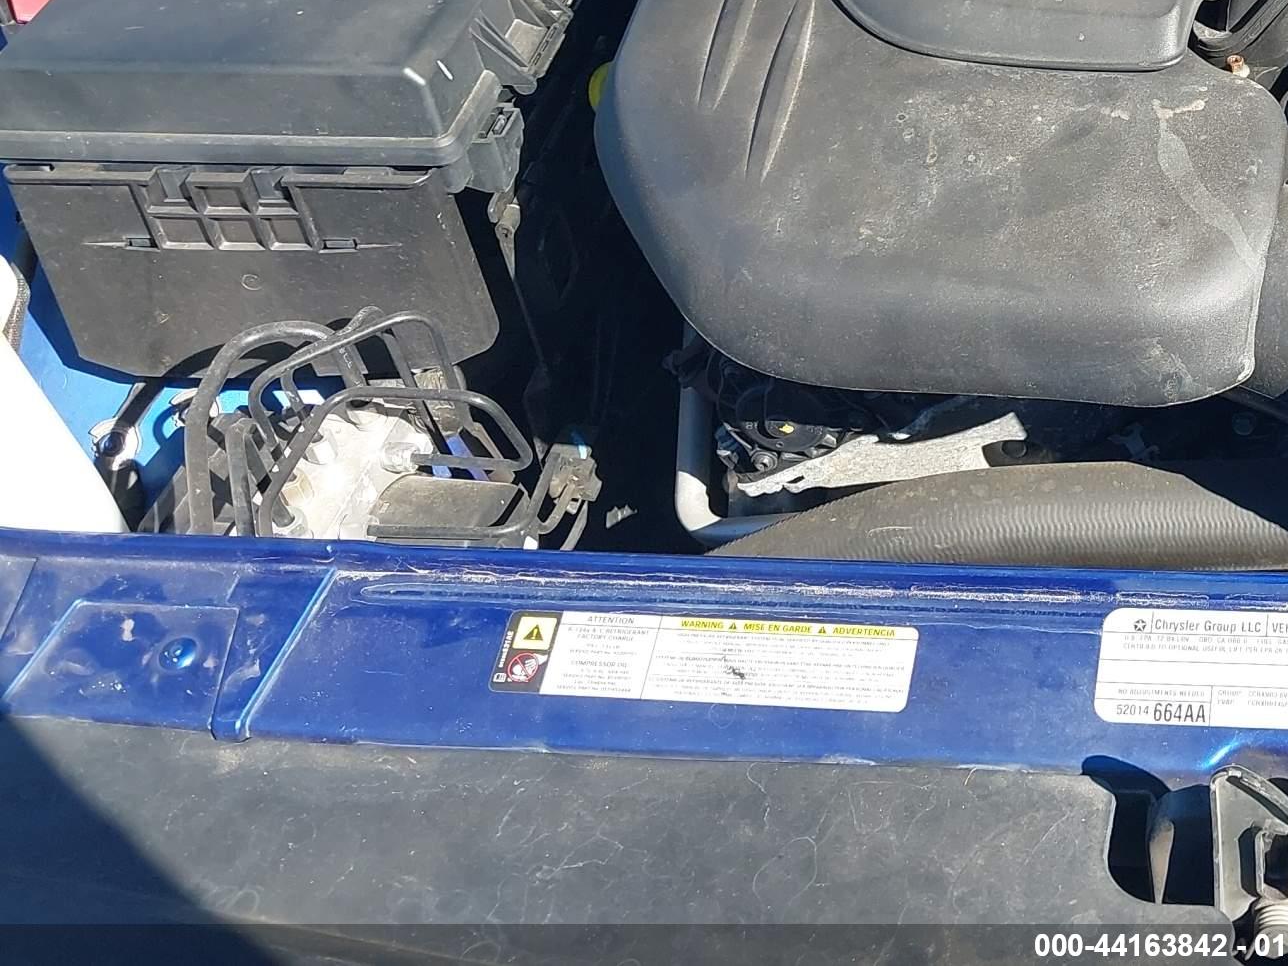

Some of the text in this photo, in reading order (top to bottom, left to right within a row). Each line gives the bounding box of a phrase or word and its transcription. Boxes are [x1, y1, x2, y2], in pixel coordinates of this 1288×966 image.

[681, 620, 724, 630] WARNING
[743, 622, 812, 633] MISE EN GARDE
[1154, 618, 1262, 634] Chrysler Group LLC
[832, 626, 896, 637] ADVERTENCIA
[1116, 702, 1206, 723] 52014 664AA
